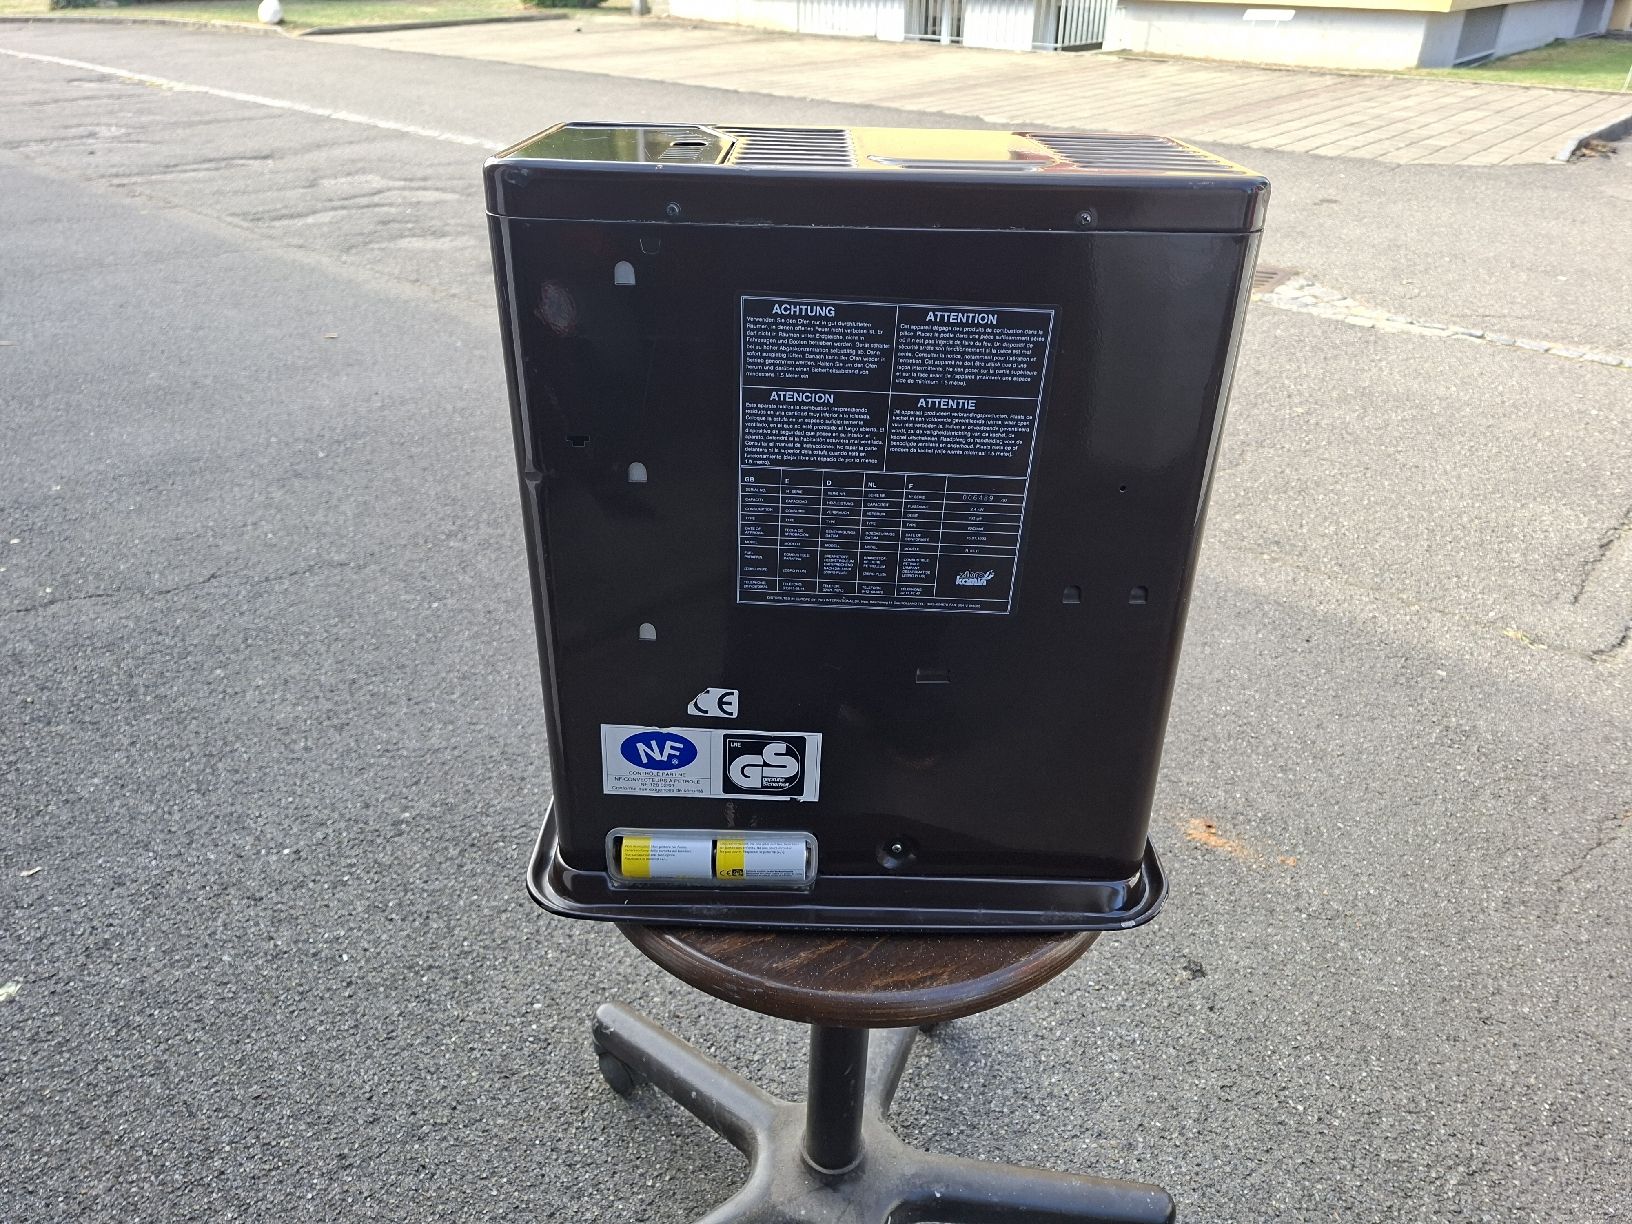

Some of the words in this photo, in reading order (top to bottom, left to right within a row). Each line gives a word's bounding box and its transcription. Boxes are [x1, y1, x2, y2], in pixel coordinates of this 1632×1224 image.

[772, 304, 835, 316] ACHTUNG
[926, 311, 997, 323] ATTENTION
[769, 391, 834, 402] ATENCION
[917, 398, 976, 409] ATTENTIE
[694, 690, 735, 716] CE
[636, 740, 684, 764] NF
[730, 743, 799, 788] GS
